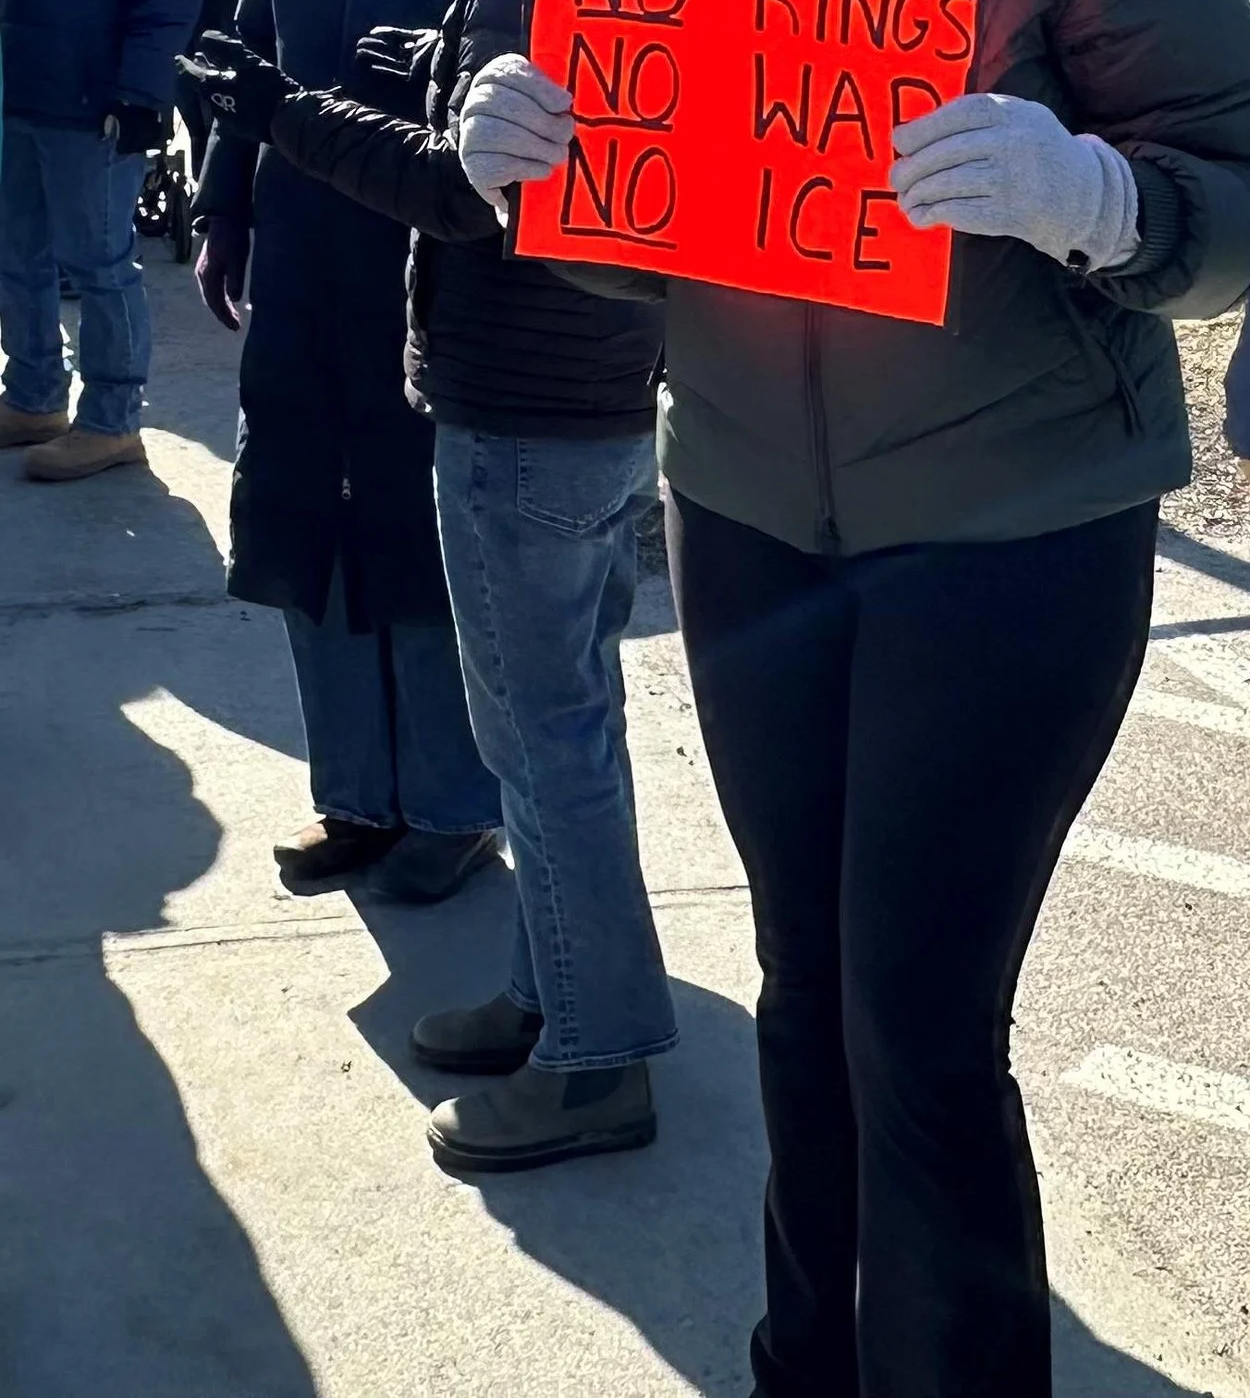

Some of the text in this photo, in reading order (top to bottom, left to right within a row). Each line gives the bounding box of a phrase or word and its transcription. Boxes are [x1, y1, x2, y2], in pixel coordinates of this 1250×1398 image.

[566, 32, 681, 122] NO
[561, 135, 898, 271] NO ICE
